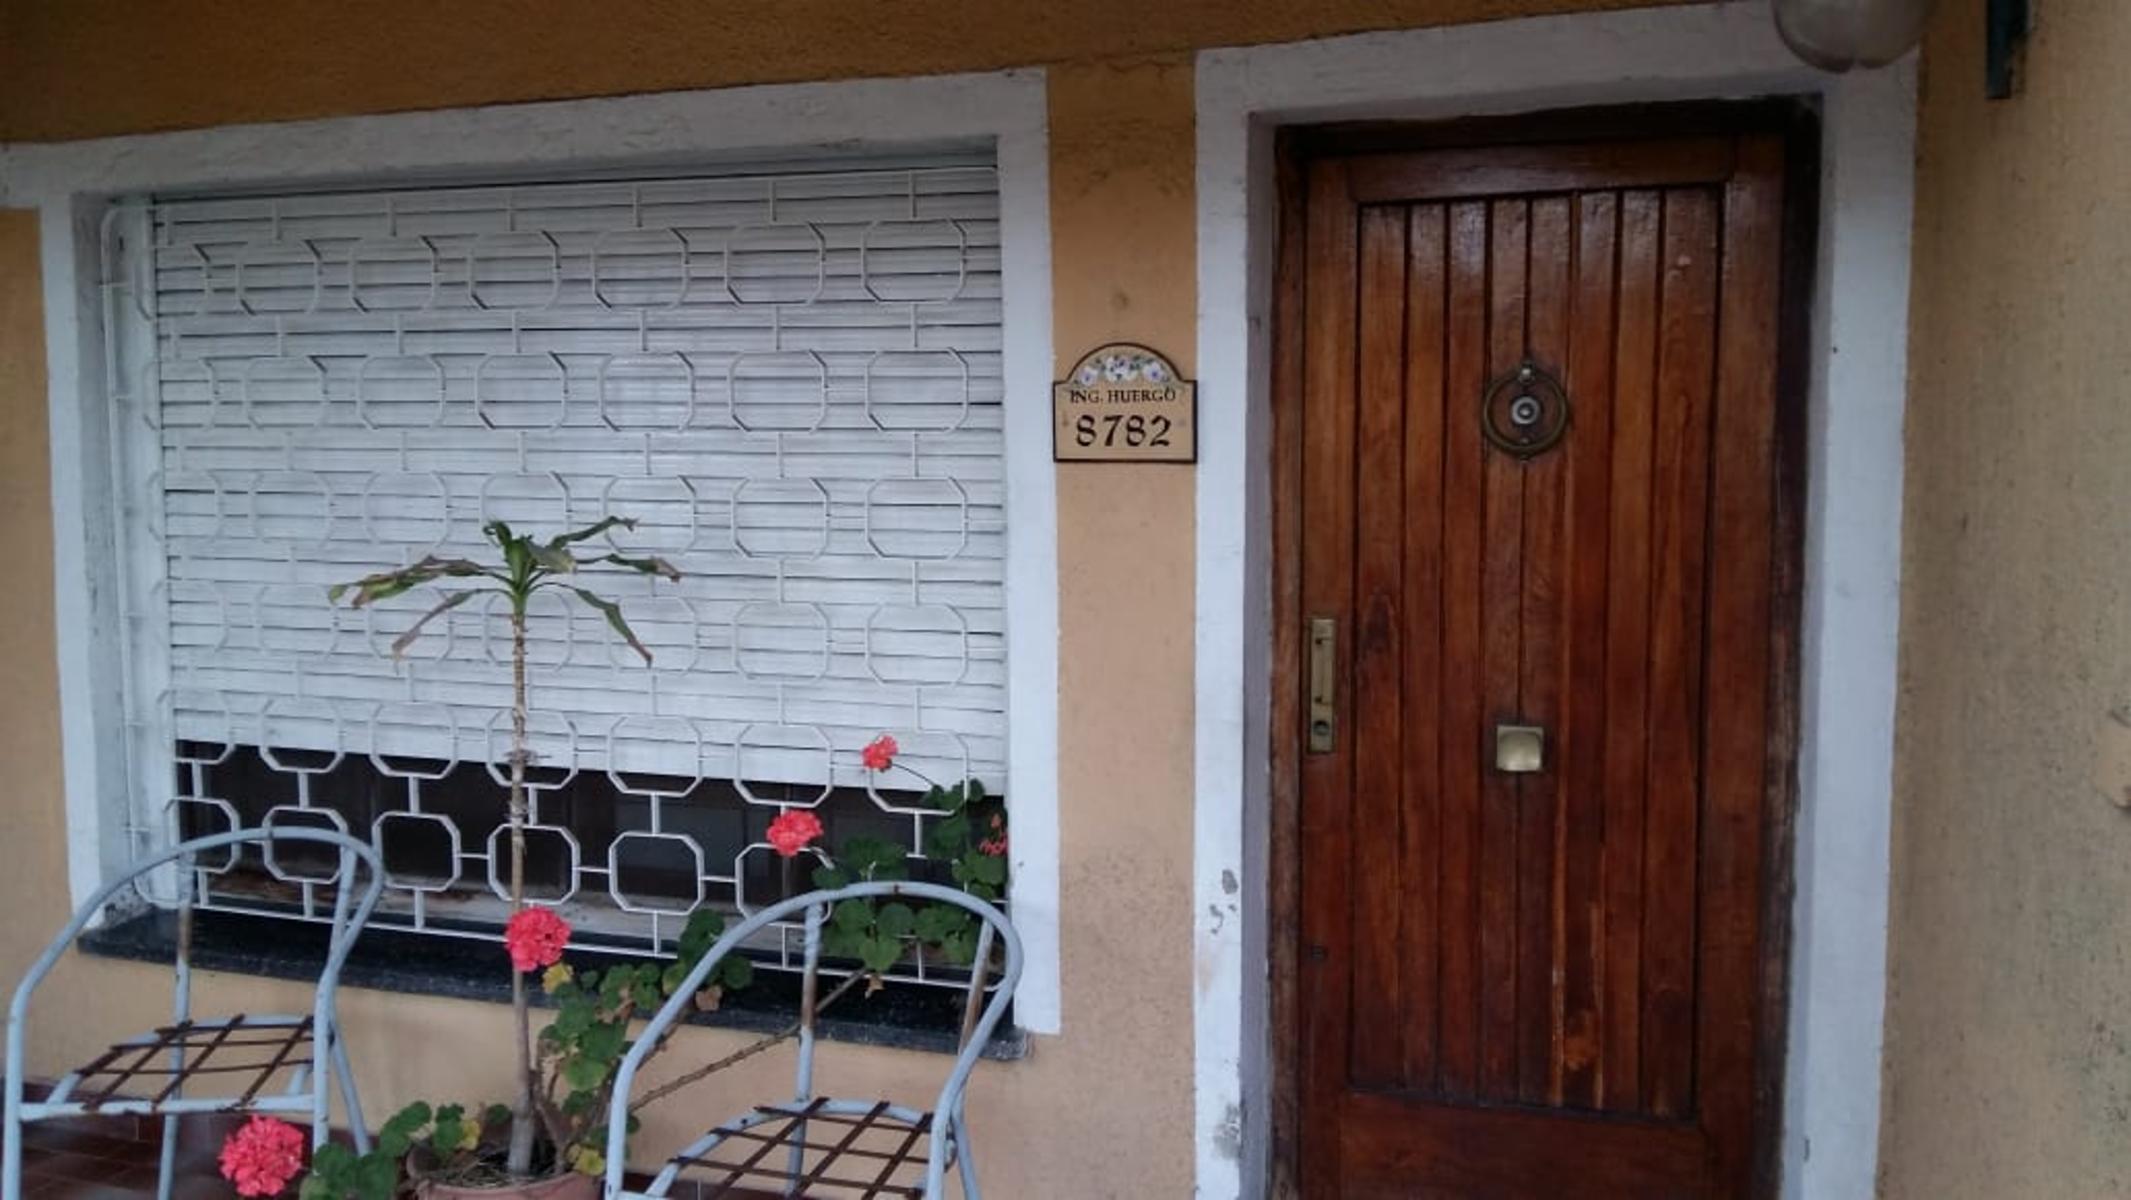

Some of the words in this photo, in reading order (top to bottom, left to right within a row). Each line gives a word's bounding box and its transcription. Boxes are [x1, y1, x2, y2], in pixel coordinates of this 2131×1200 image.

[1070, 389, 1104, 404] ING.
[1108, 389, 1176, 404] HUERGO
[1076, 414, 1172, 447] 8782
